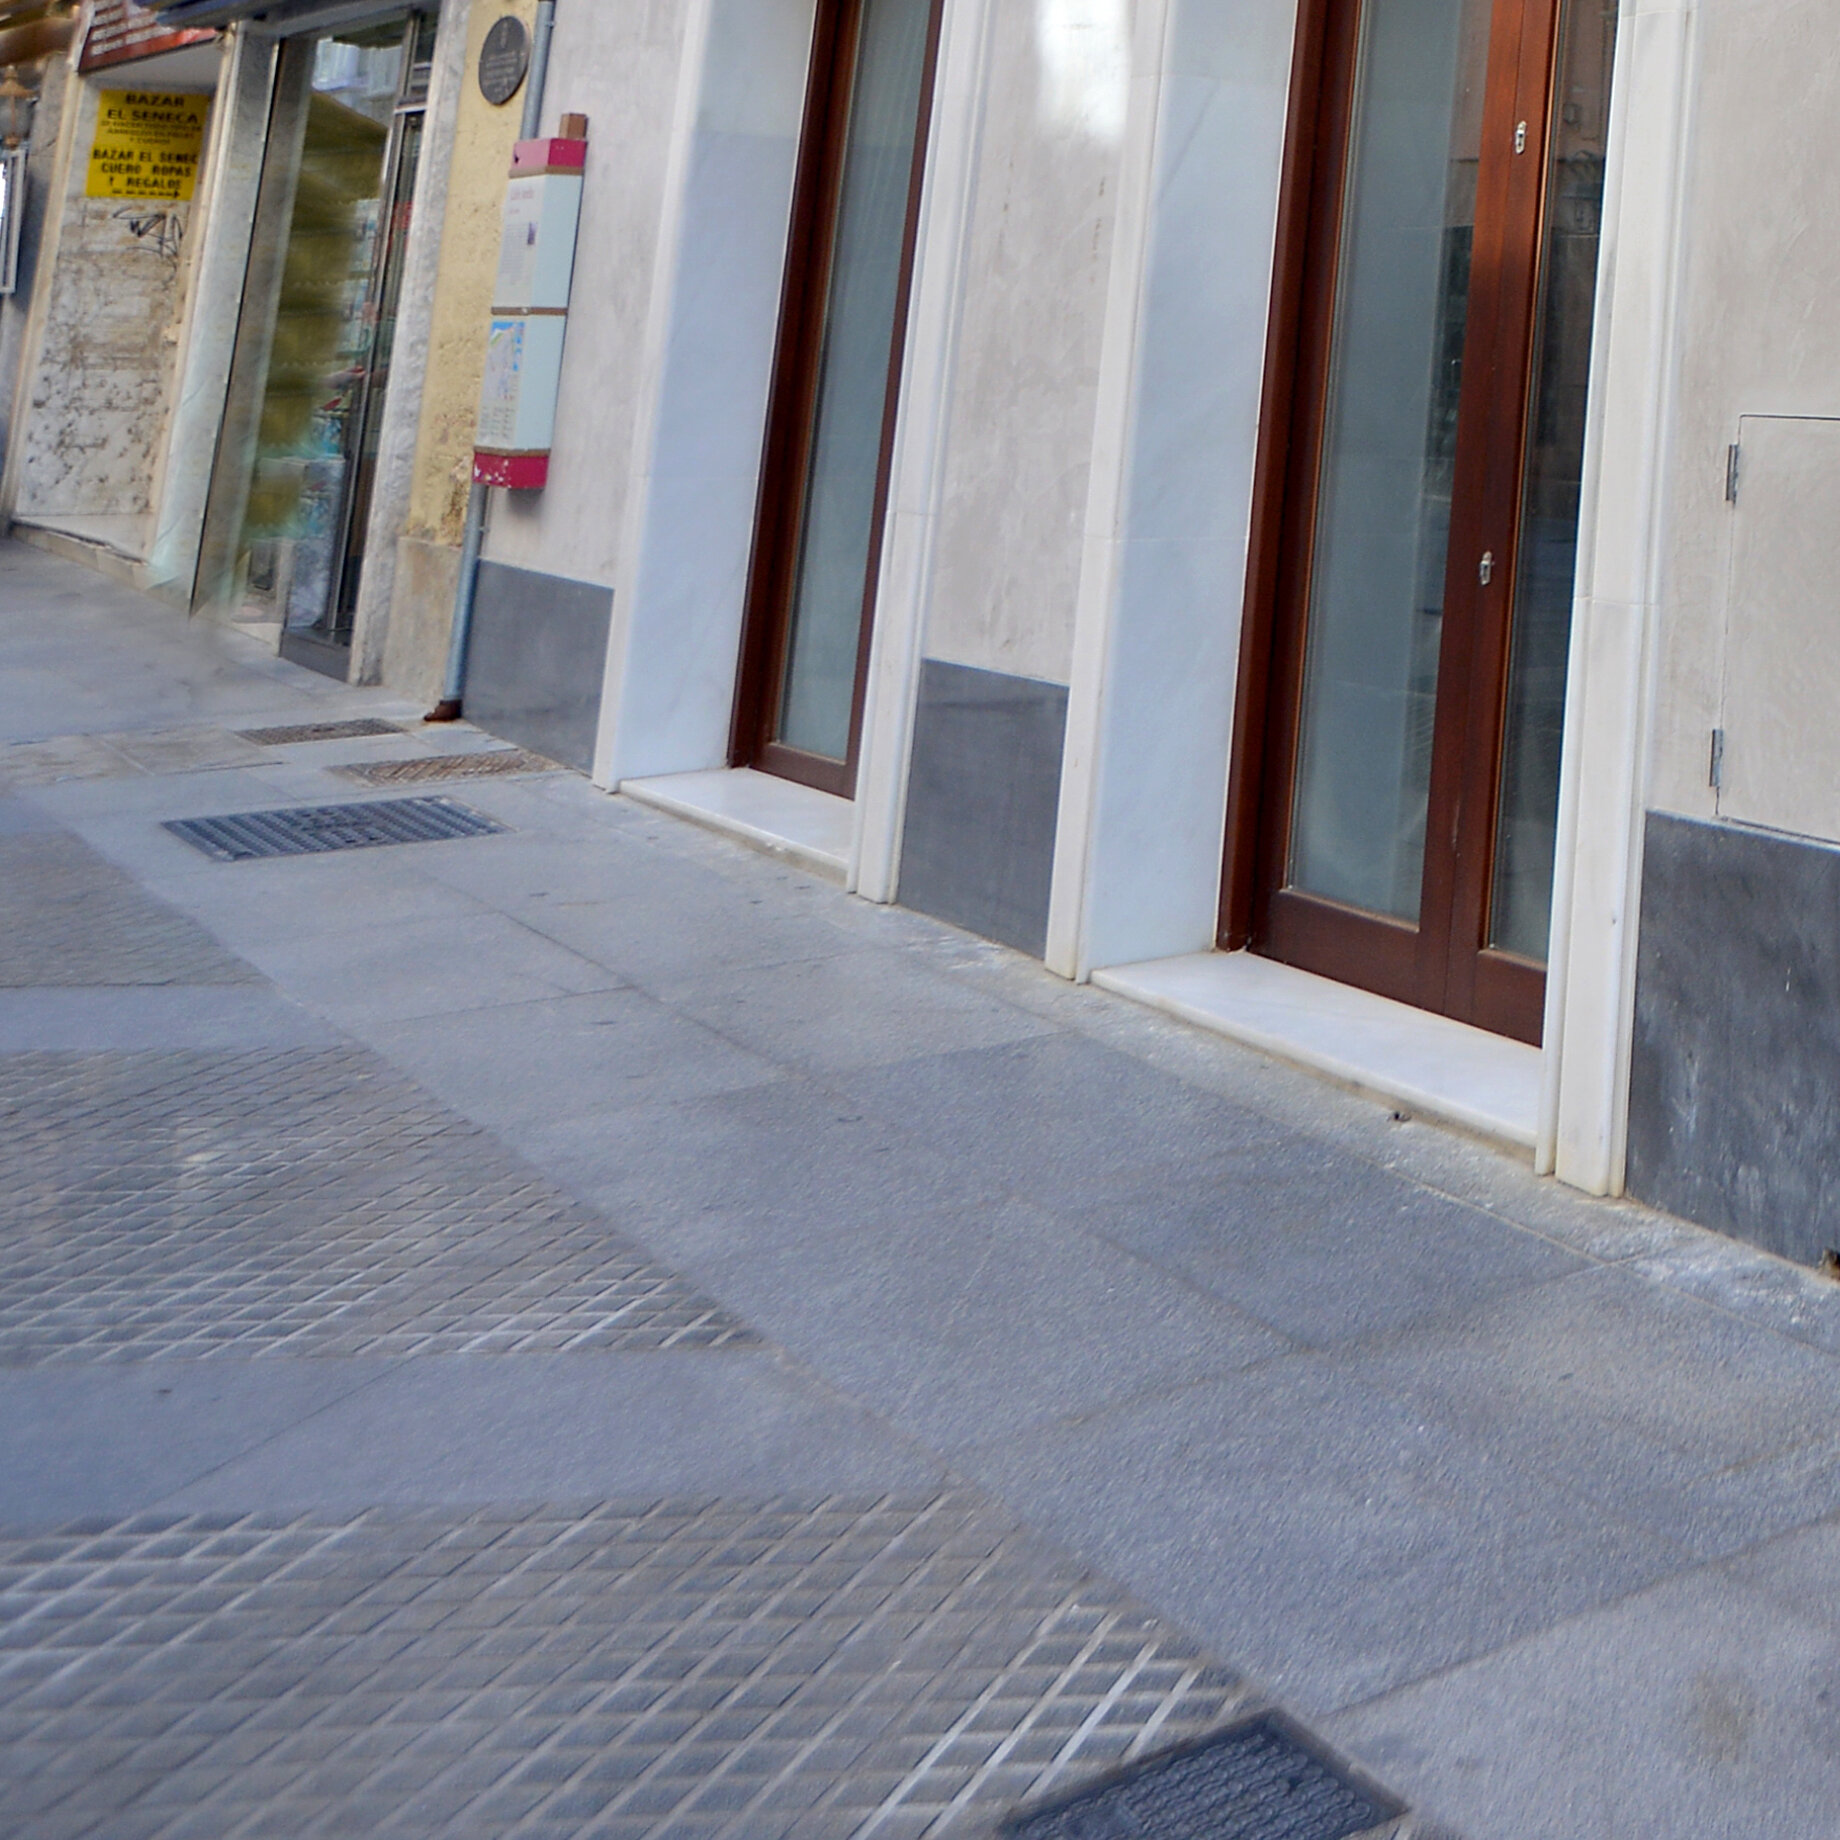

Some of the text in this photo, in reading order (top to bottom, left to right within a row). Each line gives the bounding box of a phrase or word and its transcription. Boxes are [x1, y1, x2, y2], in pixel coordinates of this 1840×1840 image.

[125, 93, 185, 107] BAZAR
[107, 109, 199, 124] EL SENECA
[93, 148, 134, 161] BAZAR
[139, 150, 153, 162] EL
[101, 163, 192, 178] CUERO ROPAS
[126, 177, 183, 191] REGALOS
